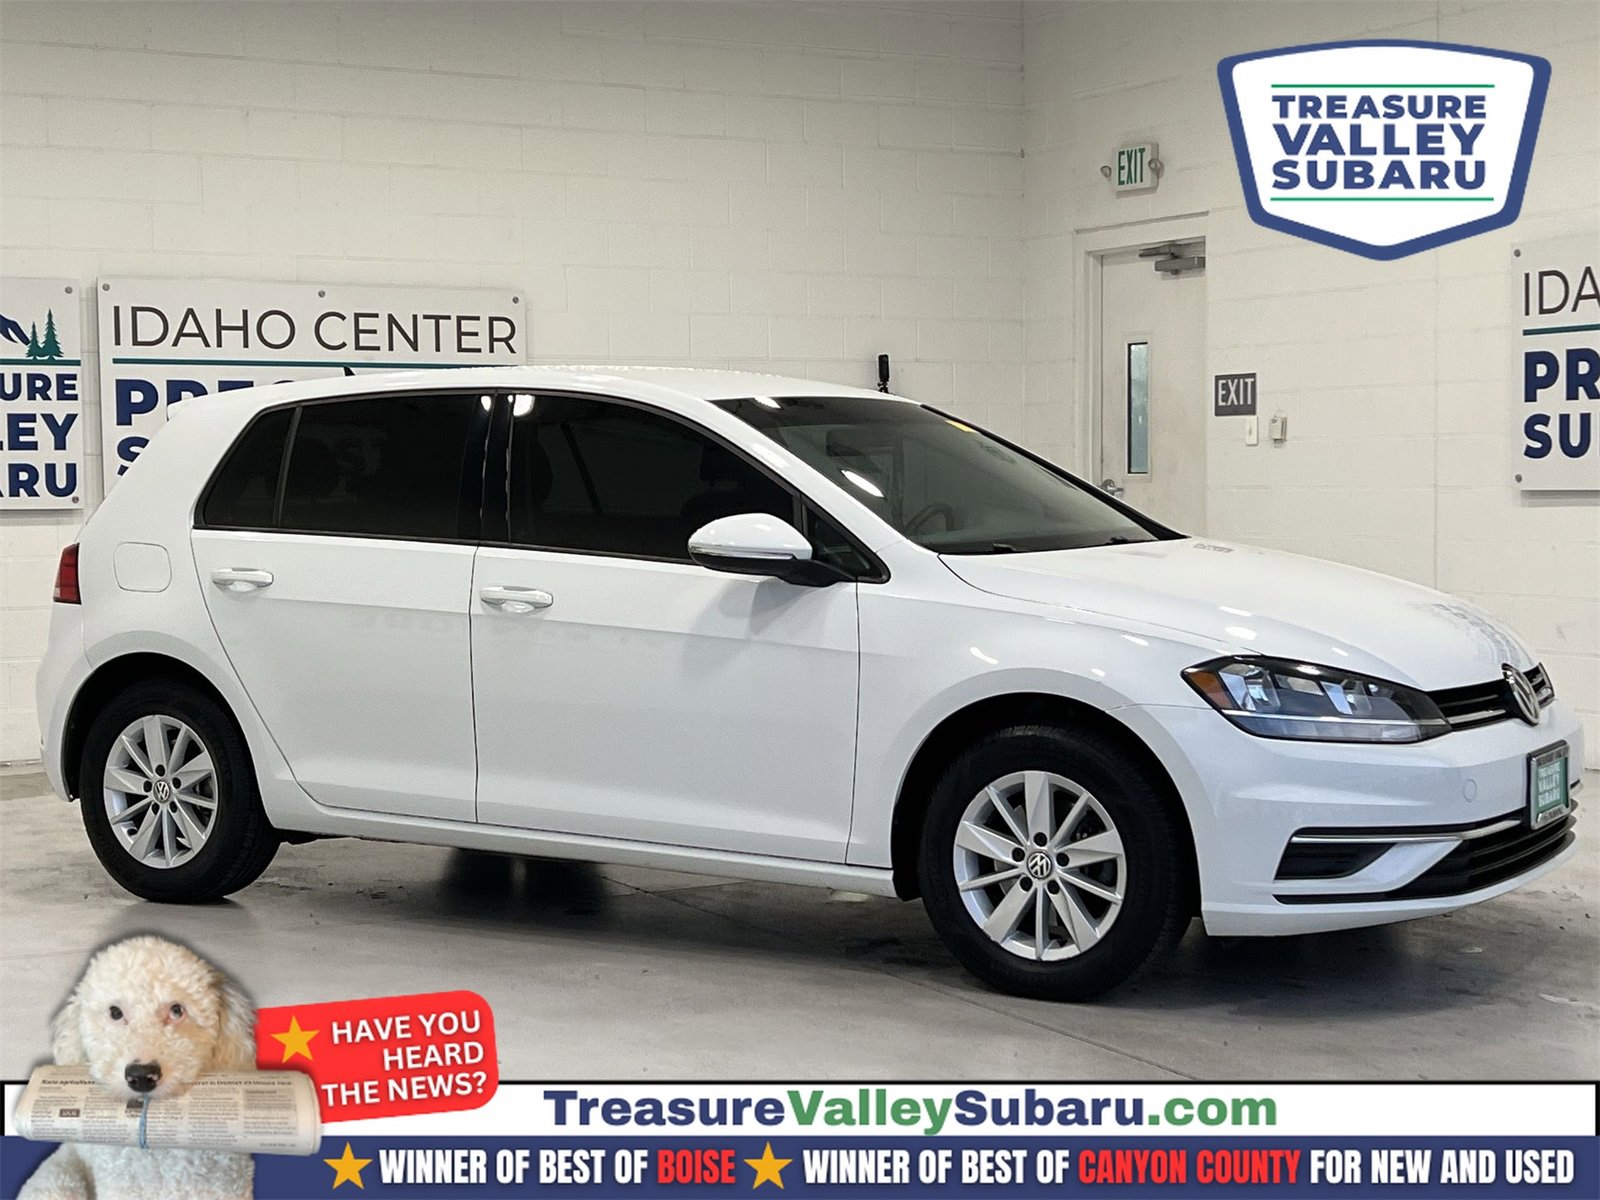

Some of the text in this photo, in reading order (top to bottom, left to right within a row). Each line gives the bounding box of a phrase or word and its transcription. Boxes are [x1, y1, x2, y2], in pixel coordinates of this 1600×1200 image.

[1118, 147, 1146, 185] EXIT
[113, 305, 518, 354] IDAHO CENTER
[1218, 378, 1255, 406] EXIT
